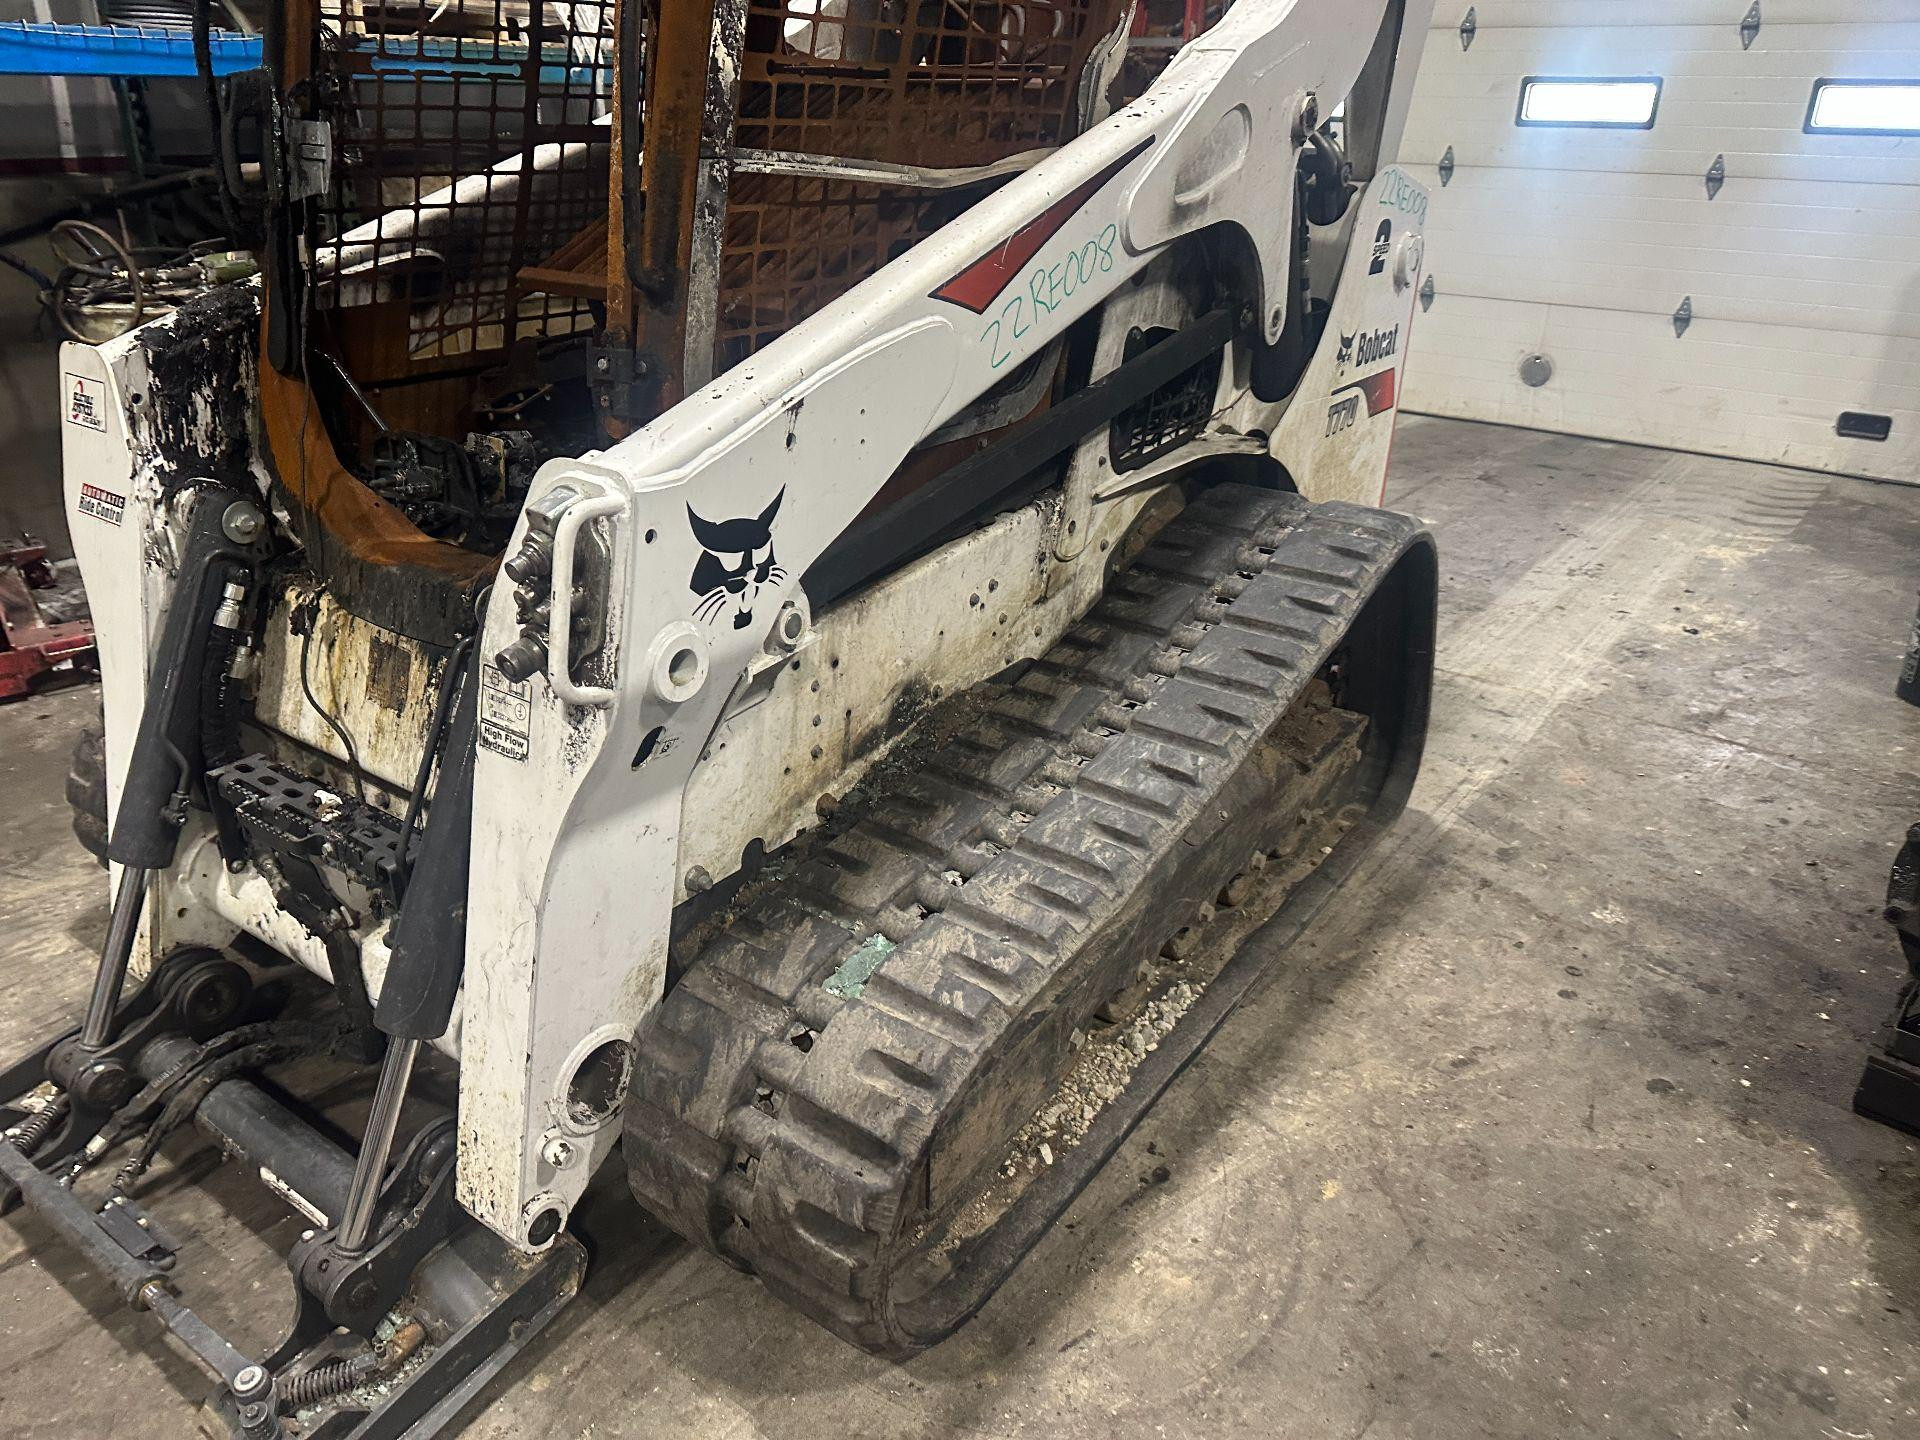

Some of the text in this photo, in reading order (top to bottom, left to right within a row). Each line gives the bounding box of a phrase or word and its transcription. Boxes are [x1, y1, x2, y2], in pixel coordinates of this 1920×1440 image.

[979, 223, 1117, 369] 22RE008
[1355, 322, 1399, 368] Bobcat
[79, 495, 124, 524] Ride Control
[82, 485, 124, 508] AUTOMATIC
[484, 725, 525, 750] High Flow
